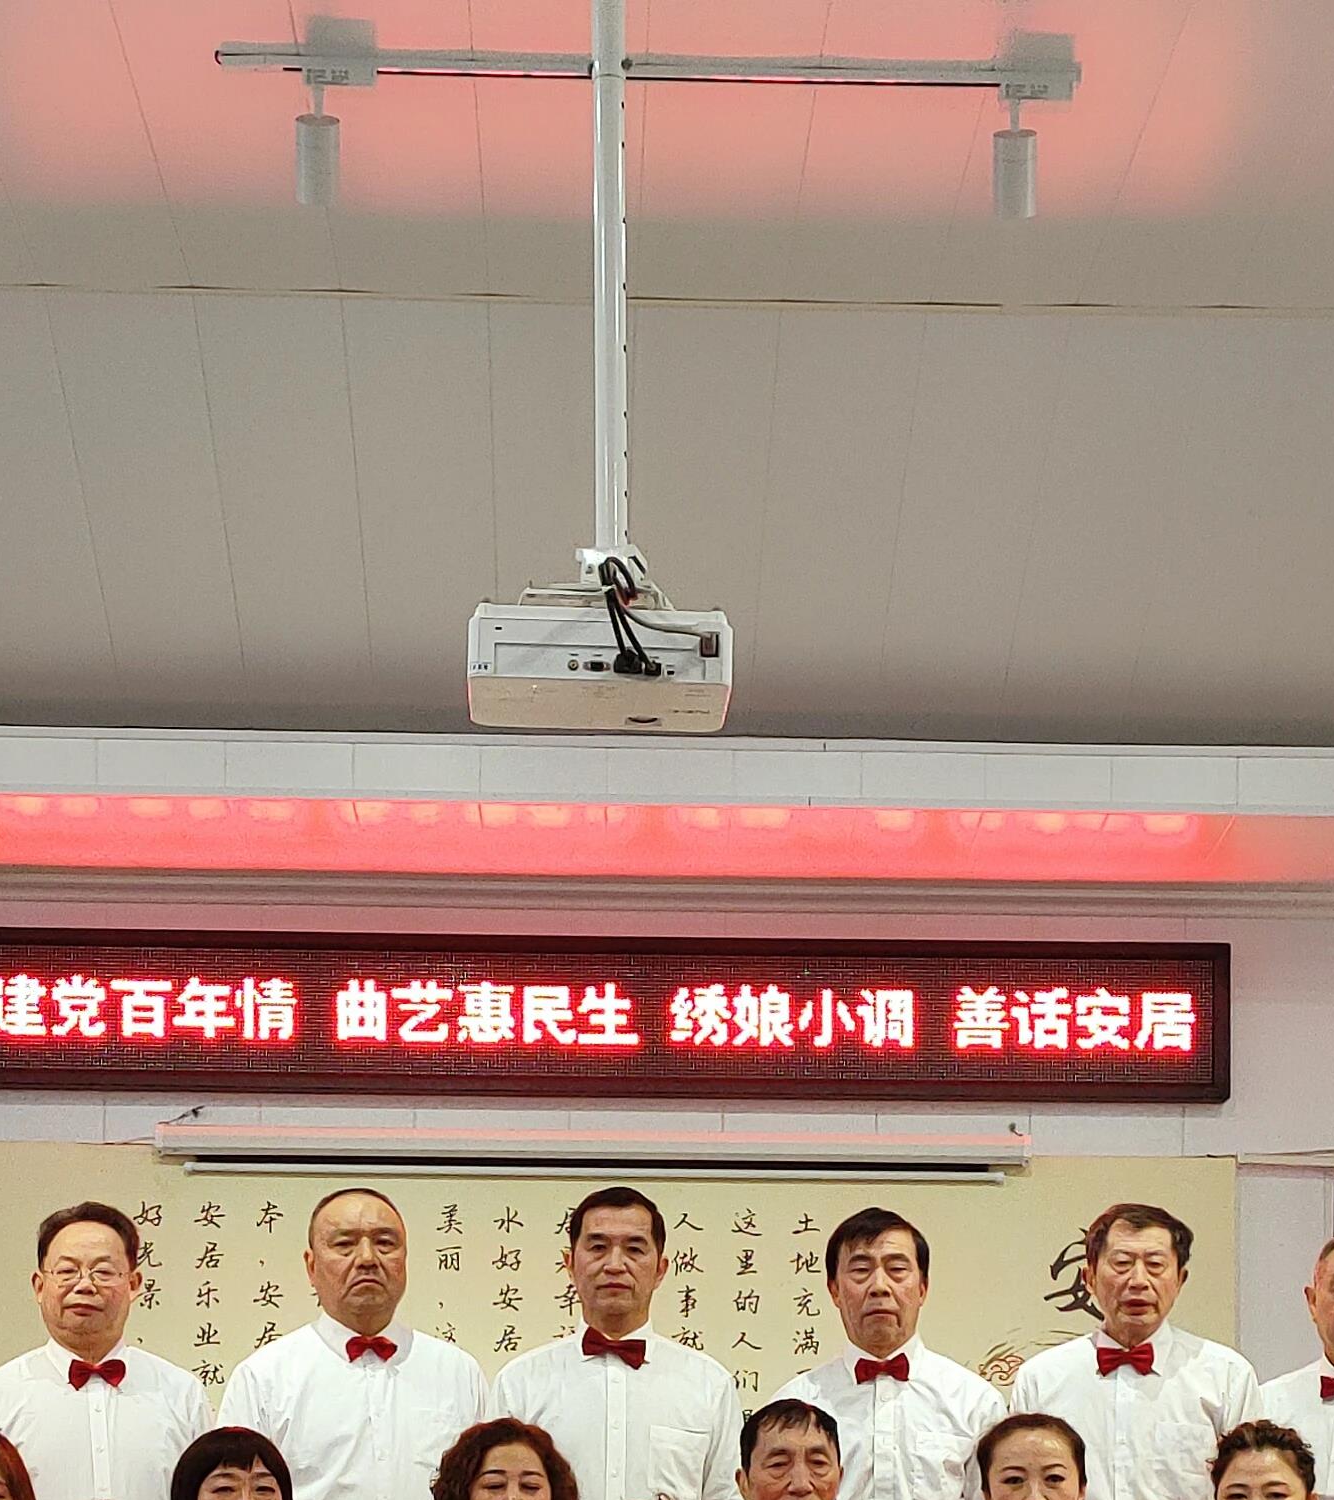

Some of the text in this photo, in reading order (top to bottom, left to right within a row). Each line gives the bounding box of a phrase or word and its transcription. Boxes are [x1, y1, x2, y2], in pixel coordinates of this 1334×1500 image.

[336, 979, 640, 1046] 曲艺惠民生
[669, 983, 915, 1048] 绣娘小调
[953, 987, 1198, 1051] 善话安居
[492, 1206, 524, 1353] 水好安居
[671, 1212, 704, 1351] 人做事就
[731, 1208, 763, 1424] 这里的人们
[789, 1213, 821, 1376] 土地充满
